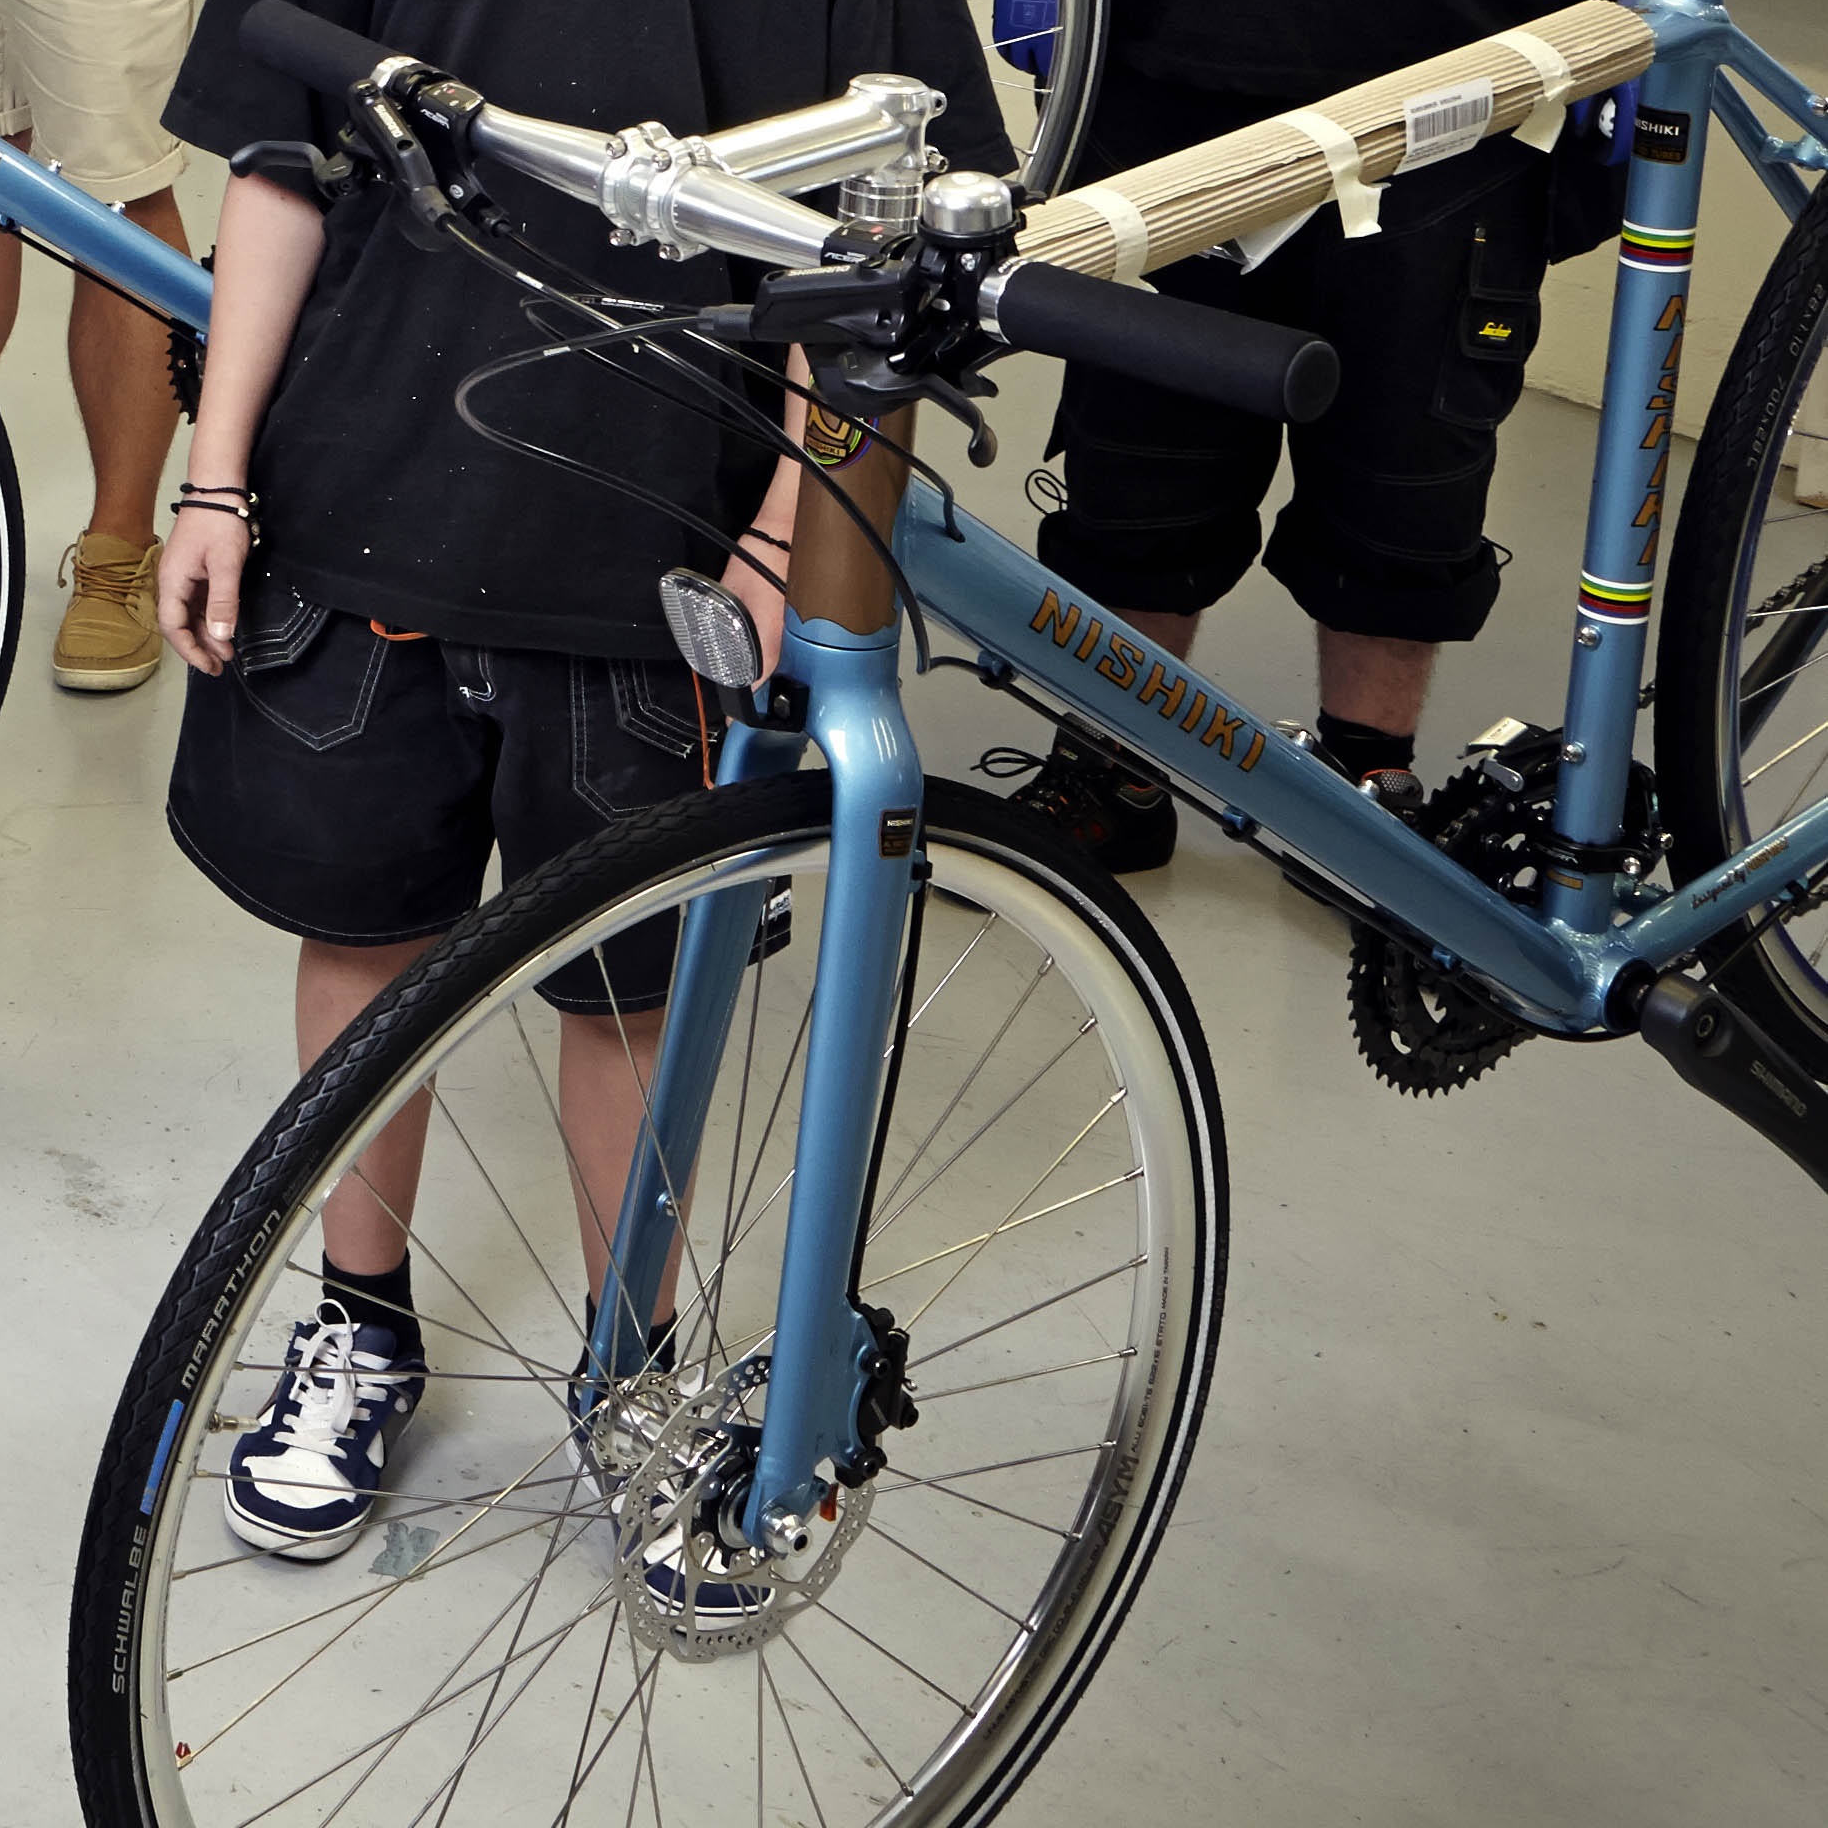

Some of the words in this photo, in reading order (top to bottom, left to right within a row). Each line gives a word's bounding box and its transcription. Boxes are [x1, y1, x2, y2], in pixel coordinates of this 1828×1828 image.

[1029, 587, 1266, 773] NISHIKI
[111, 1522, 148, 1695] SCHWALBE
[181, 1207, 282, 1393] MARATHON
[1097, 1455, 1140, 1546] ASYM
